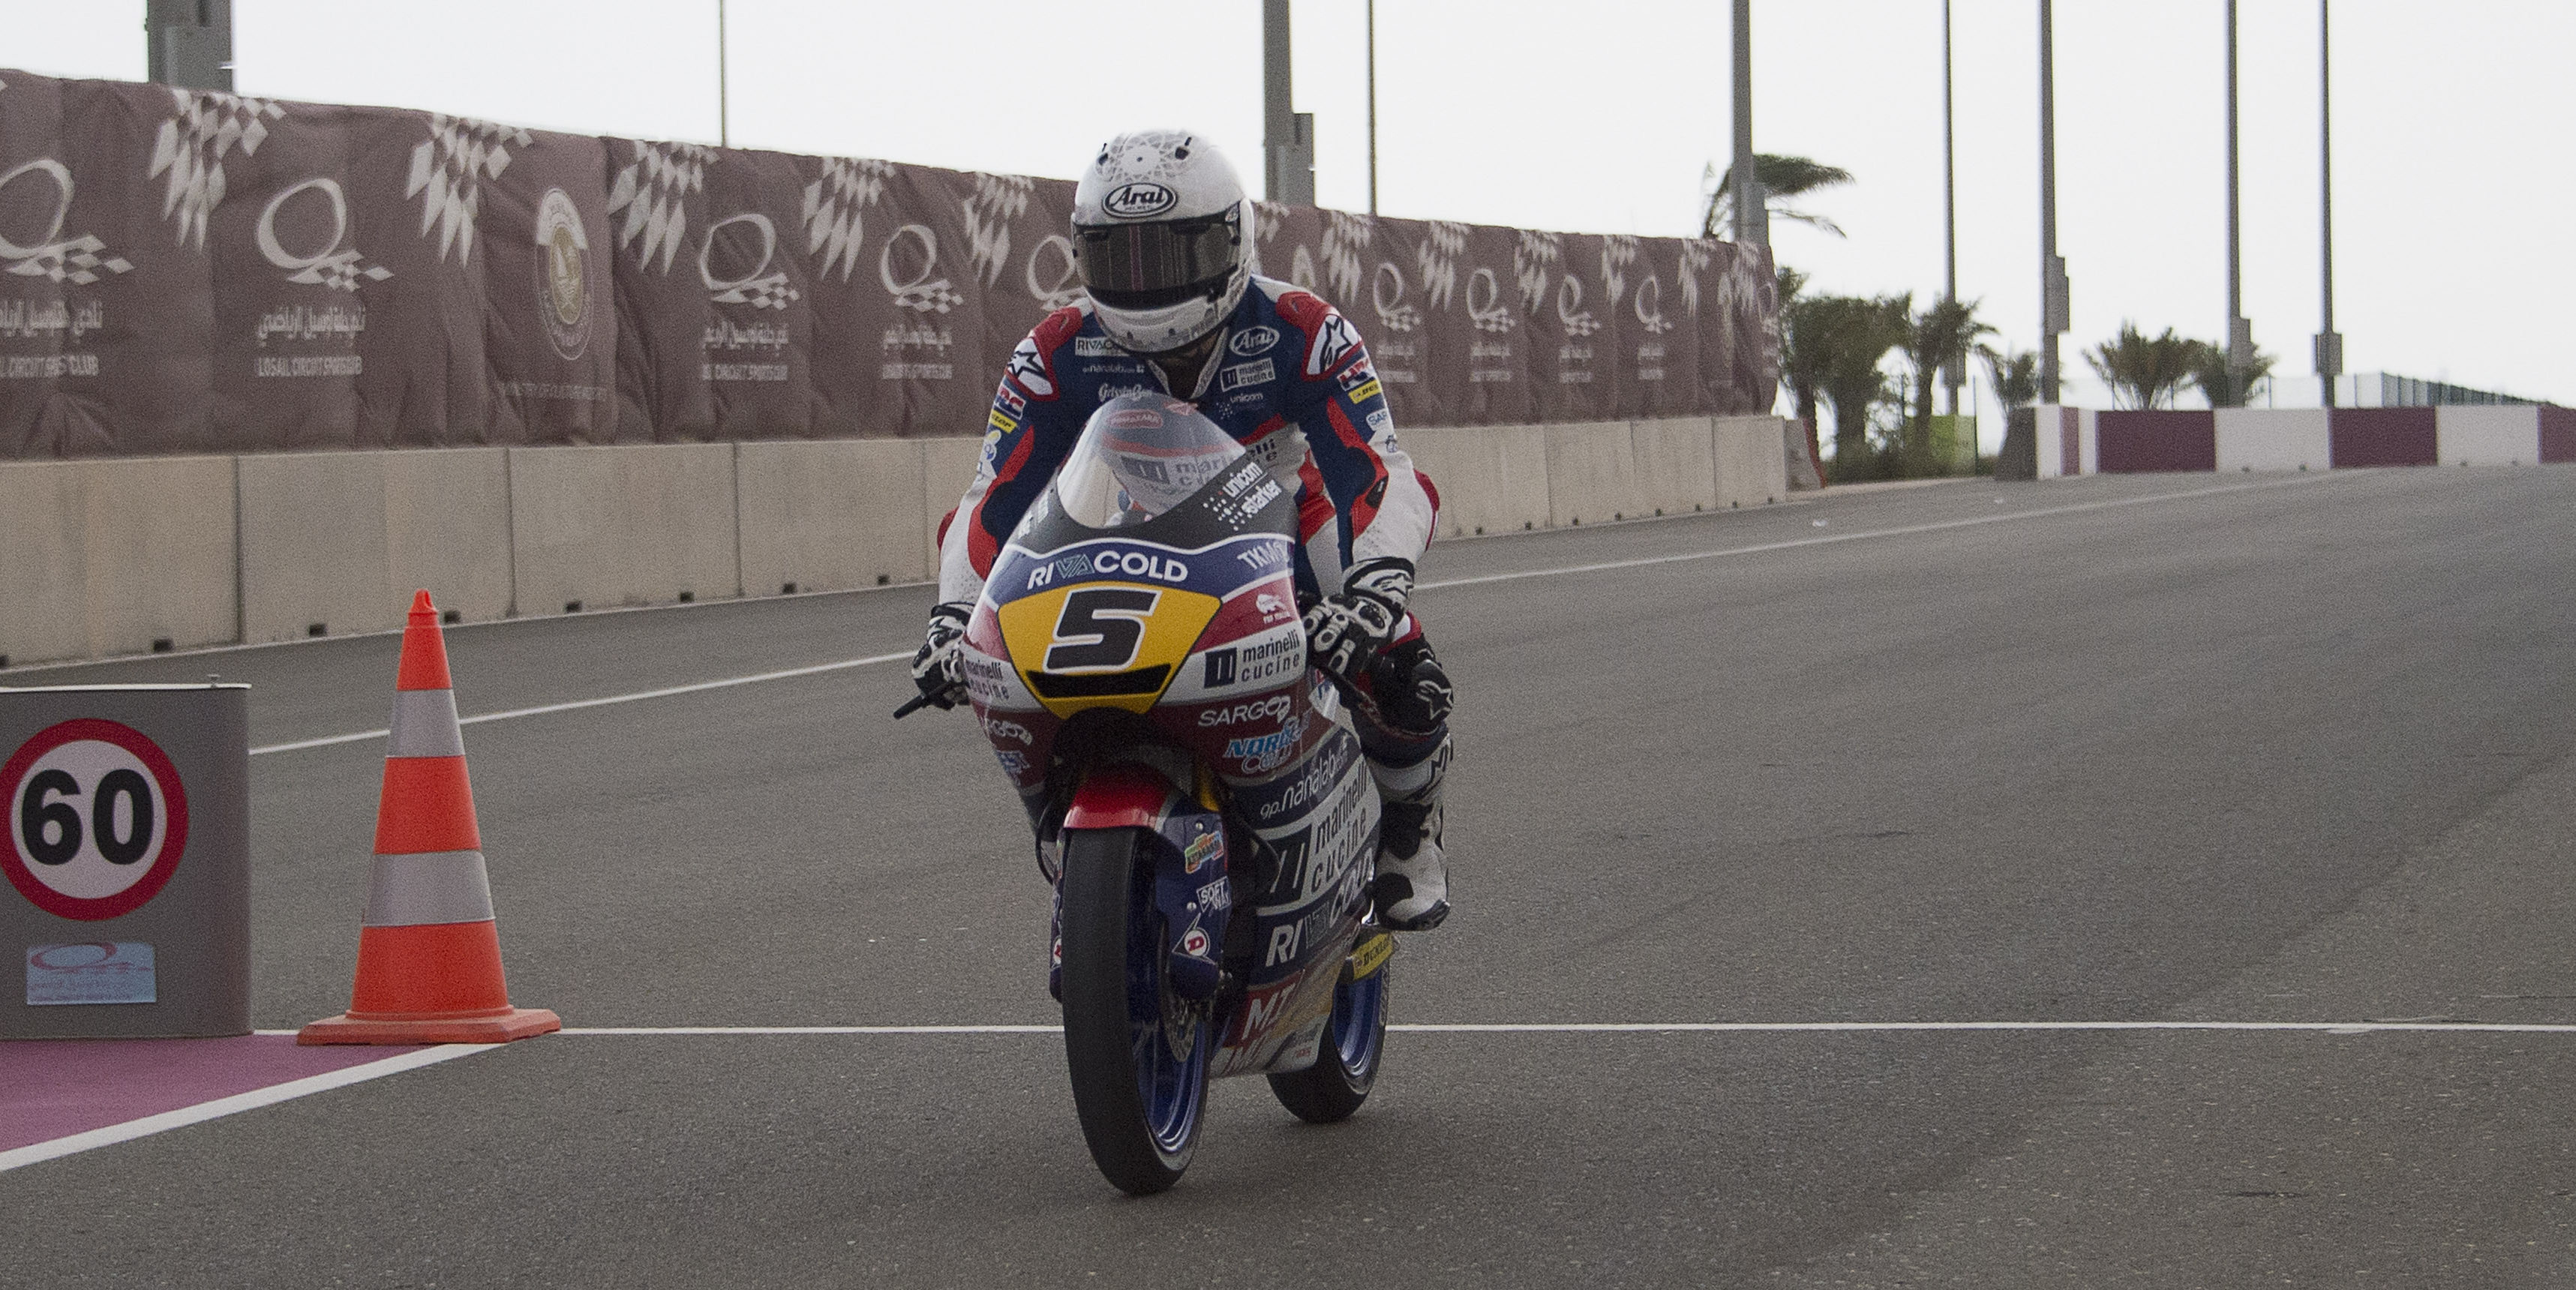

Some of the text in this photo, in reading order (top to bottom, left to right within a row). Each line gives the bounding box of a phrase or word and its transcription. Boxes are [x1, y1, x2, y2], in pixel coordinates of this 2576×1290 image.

[1109, 185, 1165, 207] Arai
[1235, 331, 1274, 351] Arai
[1222, 461, 1263, 498] unicom
[1027, 550, 1189, 591] RIVACOLD
[1042, 586, 1163, 676] 5
[1242, 629, 1300, 663] marinelli
[1241, 652, 1300, 682] cucine
[22, 769, 155, 866] 60
[1314, 758, 1367, 854] marinelli
[1311, 807, 1366, 893] cucine
[1200, 880, 1225, 904] SOFT
